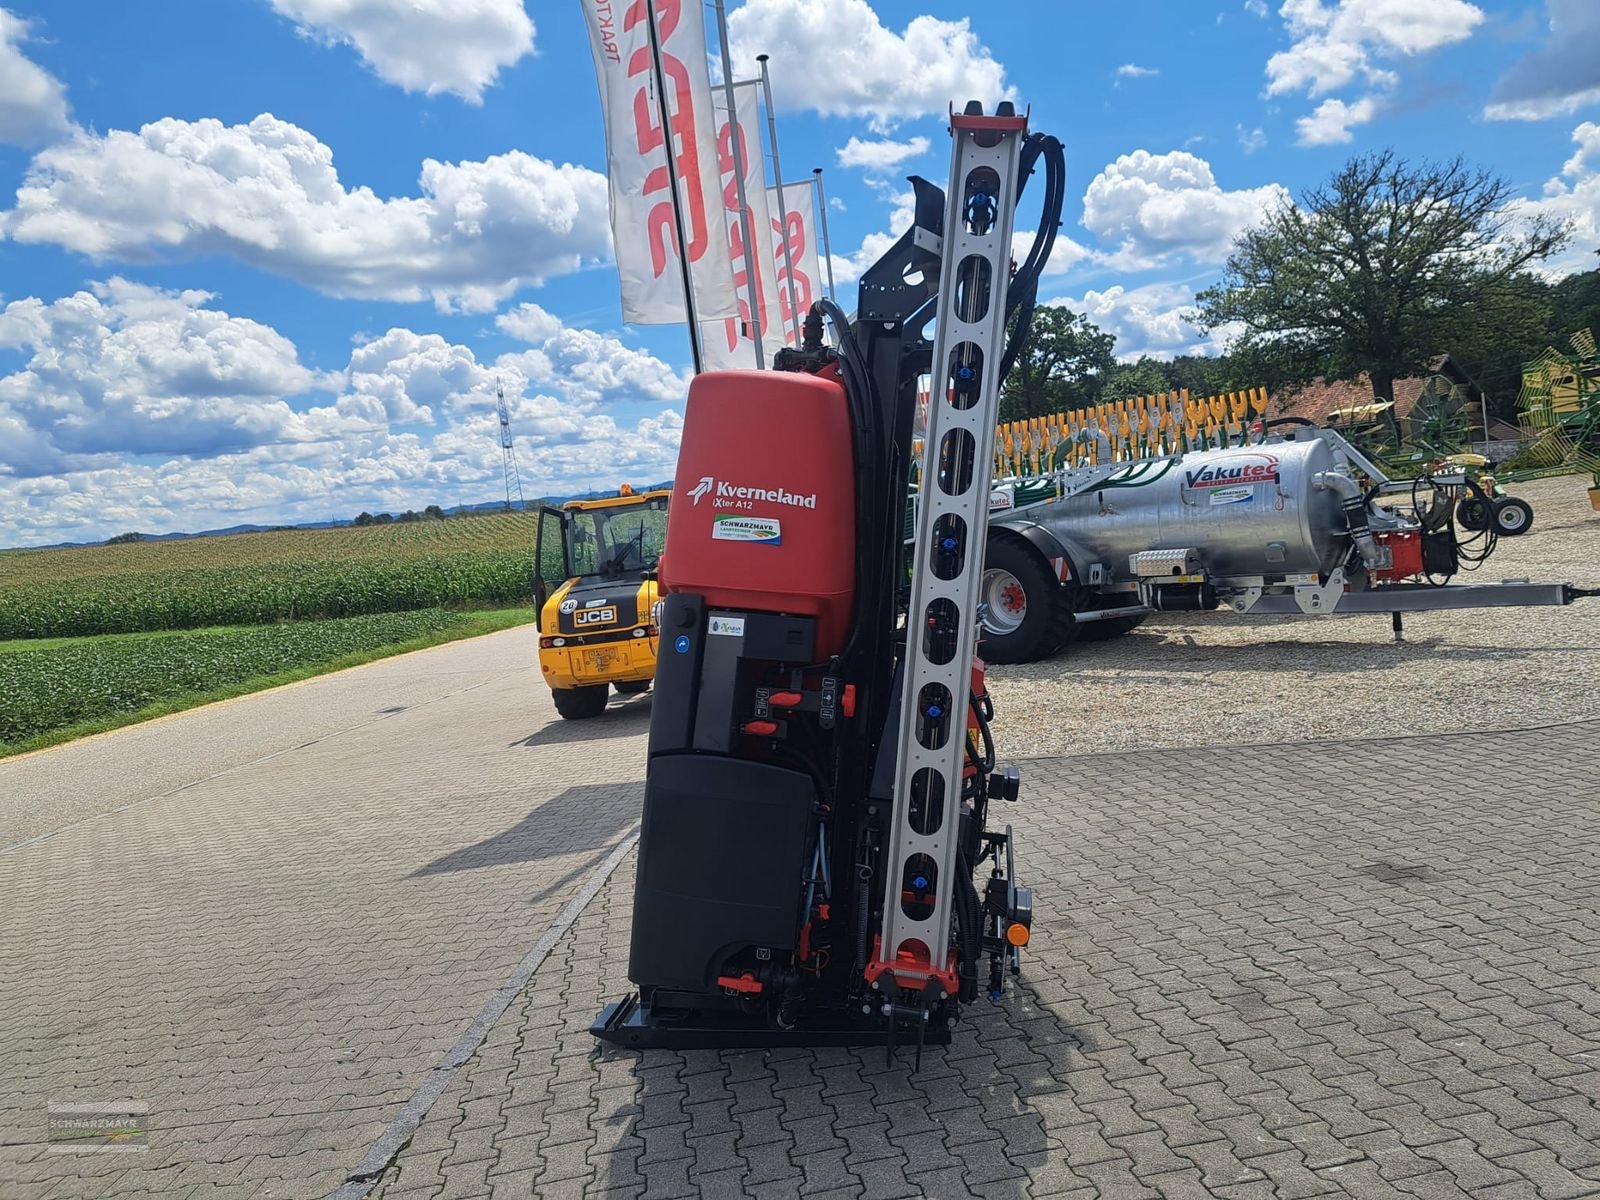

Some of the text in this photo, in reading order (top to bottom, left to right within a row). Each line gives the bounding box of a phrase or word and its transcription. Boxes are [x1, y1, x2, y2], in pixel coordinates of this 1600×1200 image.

[1185, 463, 1279, 488] Vakutec
[717, 481, 816, 509] Kverneland
[713, 498, 752, 510] iXter A12
[720, 521, 774, 531] SCHWARZMAYR
[563, 602, 574, 610] 20
[577, 609, 614, 624] JCB
